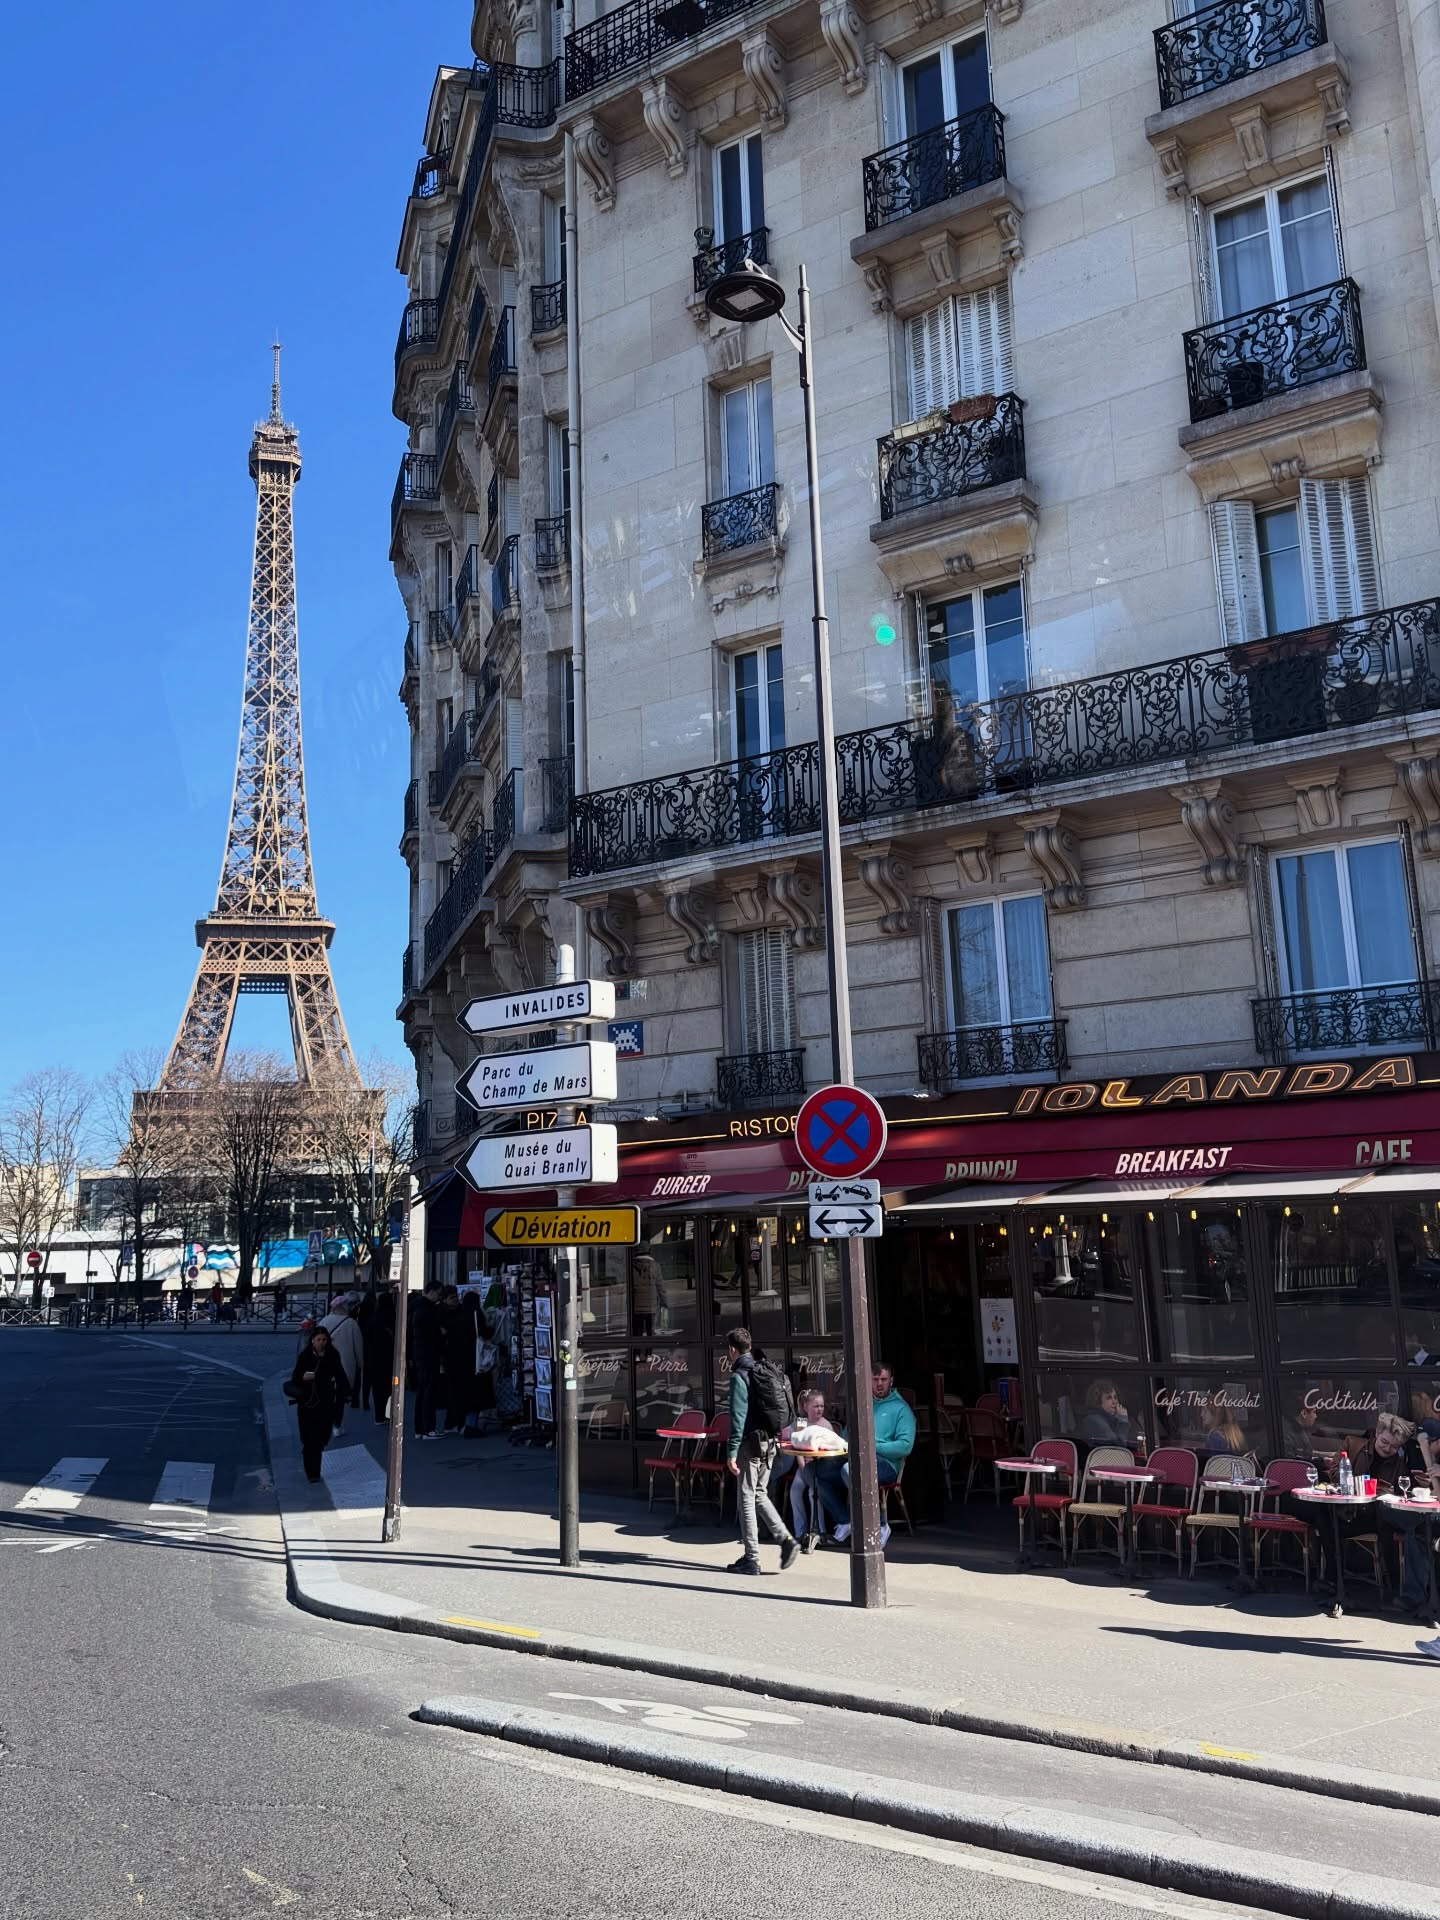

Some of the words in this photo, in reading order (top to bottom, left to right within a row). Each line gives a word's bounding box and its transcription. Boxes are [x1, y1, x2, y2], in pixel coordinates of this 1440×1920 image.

[505, 992, 585, 1019] INVALIDES
[482, 1066, 511, 1081] Parc
[518, 1061, 534, 1076] du
[482, 1084, 526, 1099] Champ
[532, 1079, 548, 1094] de
[553, 1075, 587, 1091] Mars
[1012, 1055, 1417, 1115] IOLANDA
[527, 1111, 587, 1130] PIZA
[504, 1141, 549, 1159] Musée
[556, 1138, 572, 1154] du
[504, 1161, 536, 1178] Quai
[542, 1157, 588, 1175] Branly
[1115, 1147, 1232, 1174] BREAKFAST
[651, 1174, 712, 1196] BURGER
[511, 1215, 611, 1239] Déviation
[650, 1353, 689, 1372] Pizza
[799, 1356, 822, 1375] Plat
[1303, 1388, 1379, 1411] Cocktails
